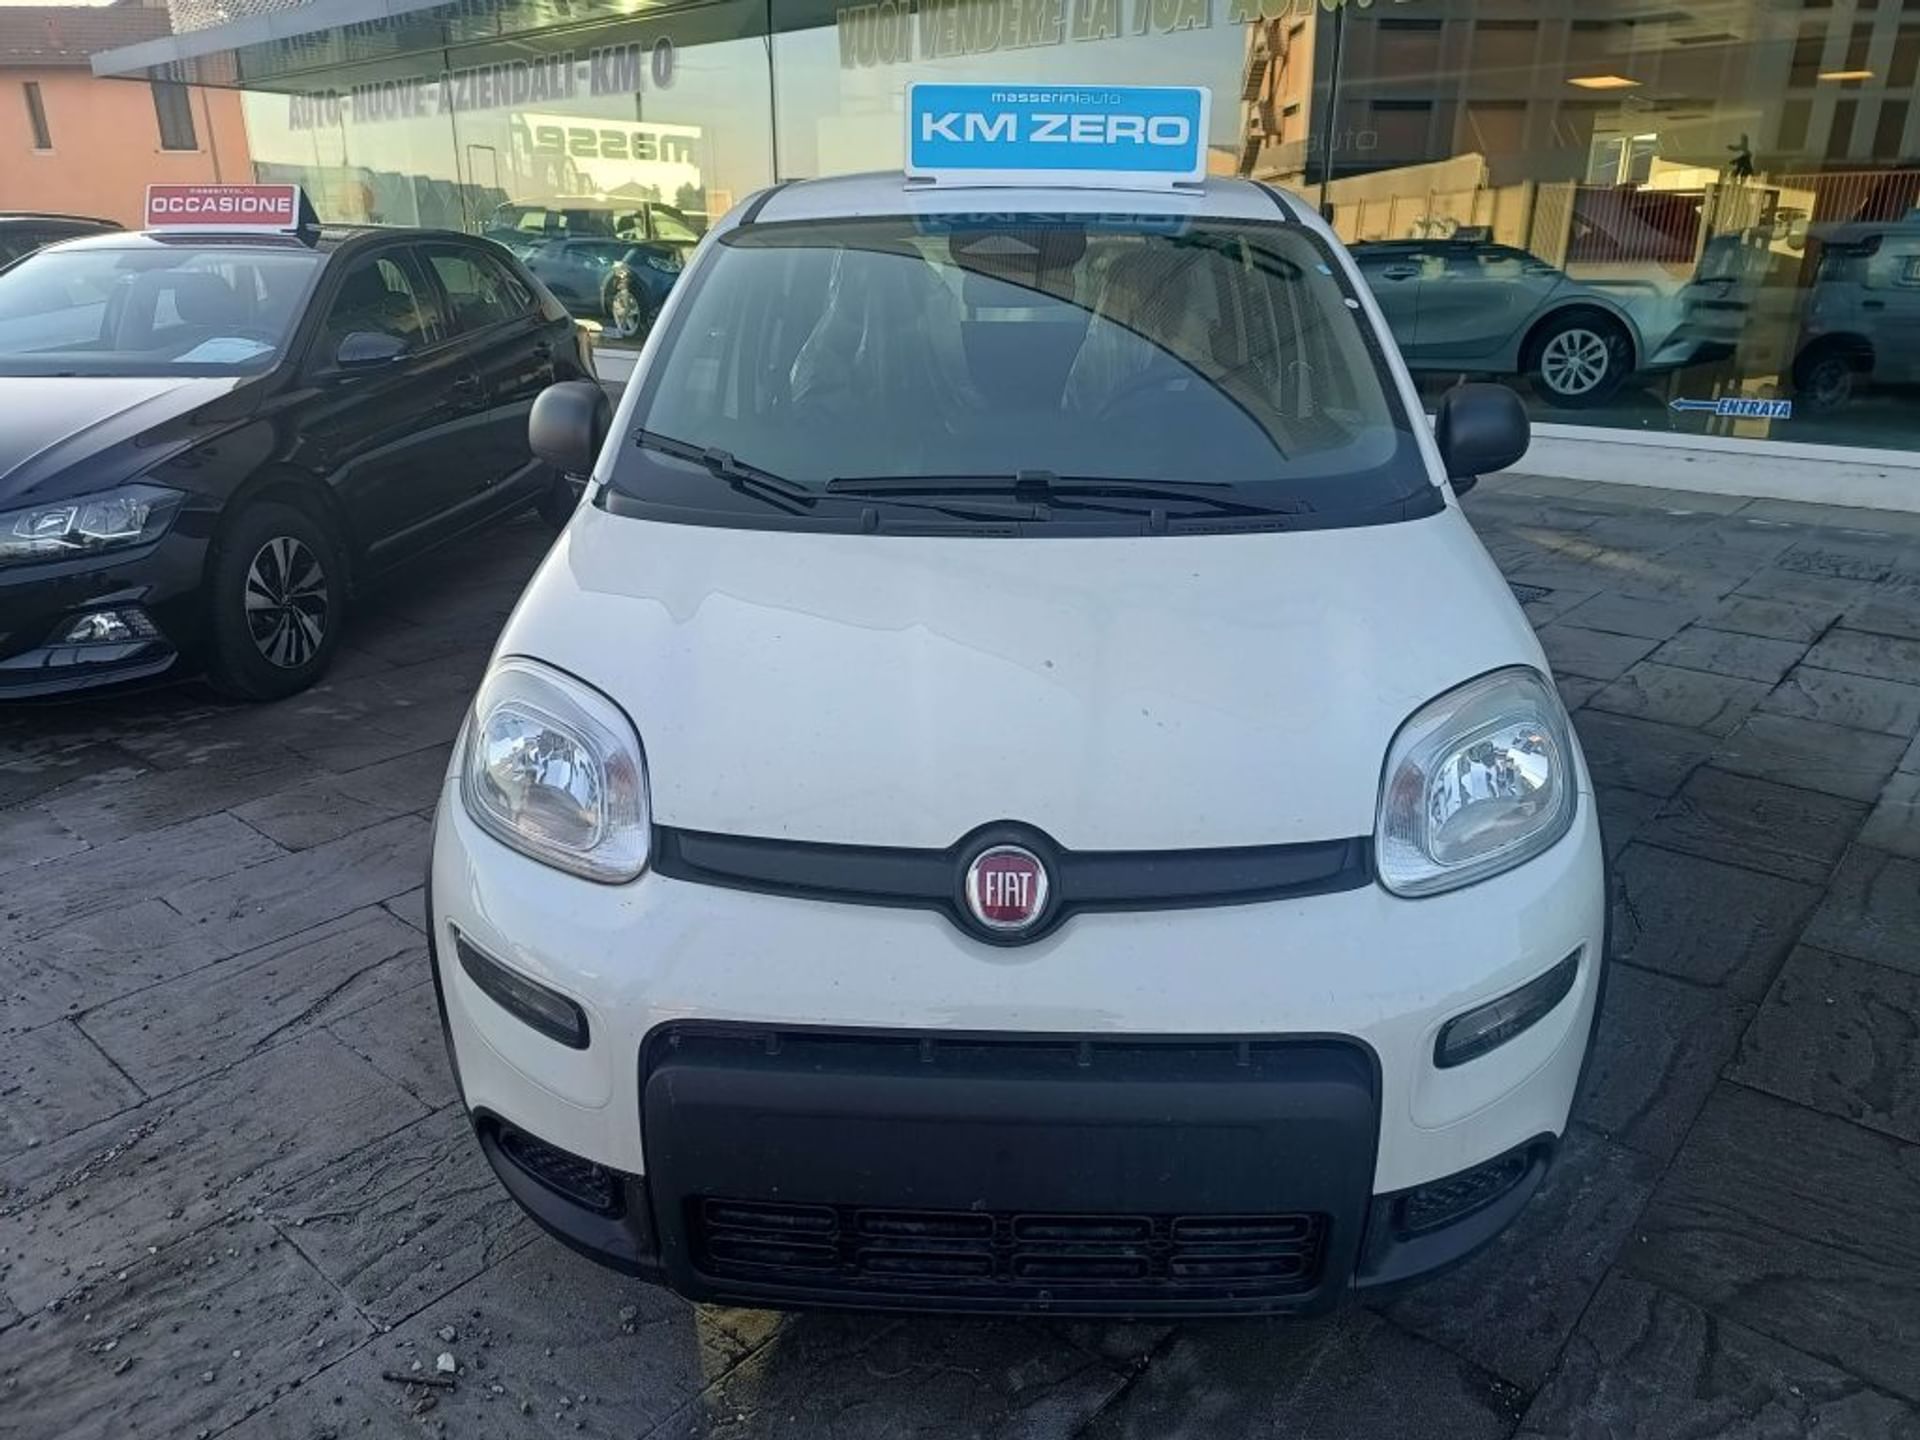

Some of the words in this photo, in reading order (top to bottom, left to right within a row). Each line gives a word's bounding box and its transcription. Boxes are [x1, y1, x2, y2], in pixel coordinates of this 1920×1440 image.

[837, 1, 912, 69] VUOI
[922, 112, 1018, 142] KM
[1029, 113, 1191, 146] ZERO
[151, 196, 291, 213] OCCASIONE
[1717, 399, 1791, 418] ENTRATA
[986, 871, 1033, 908] FIAT
